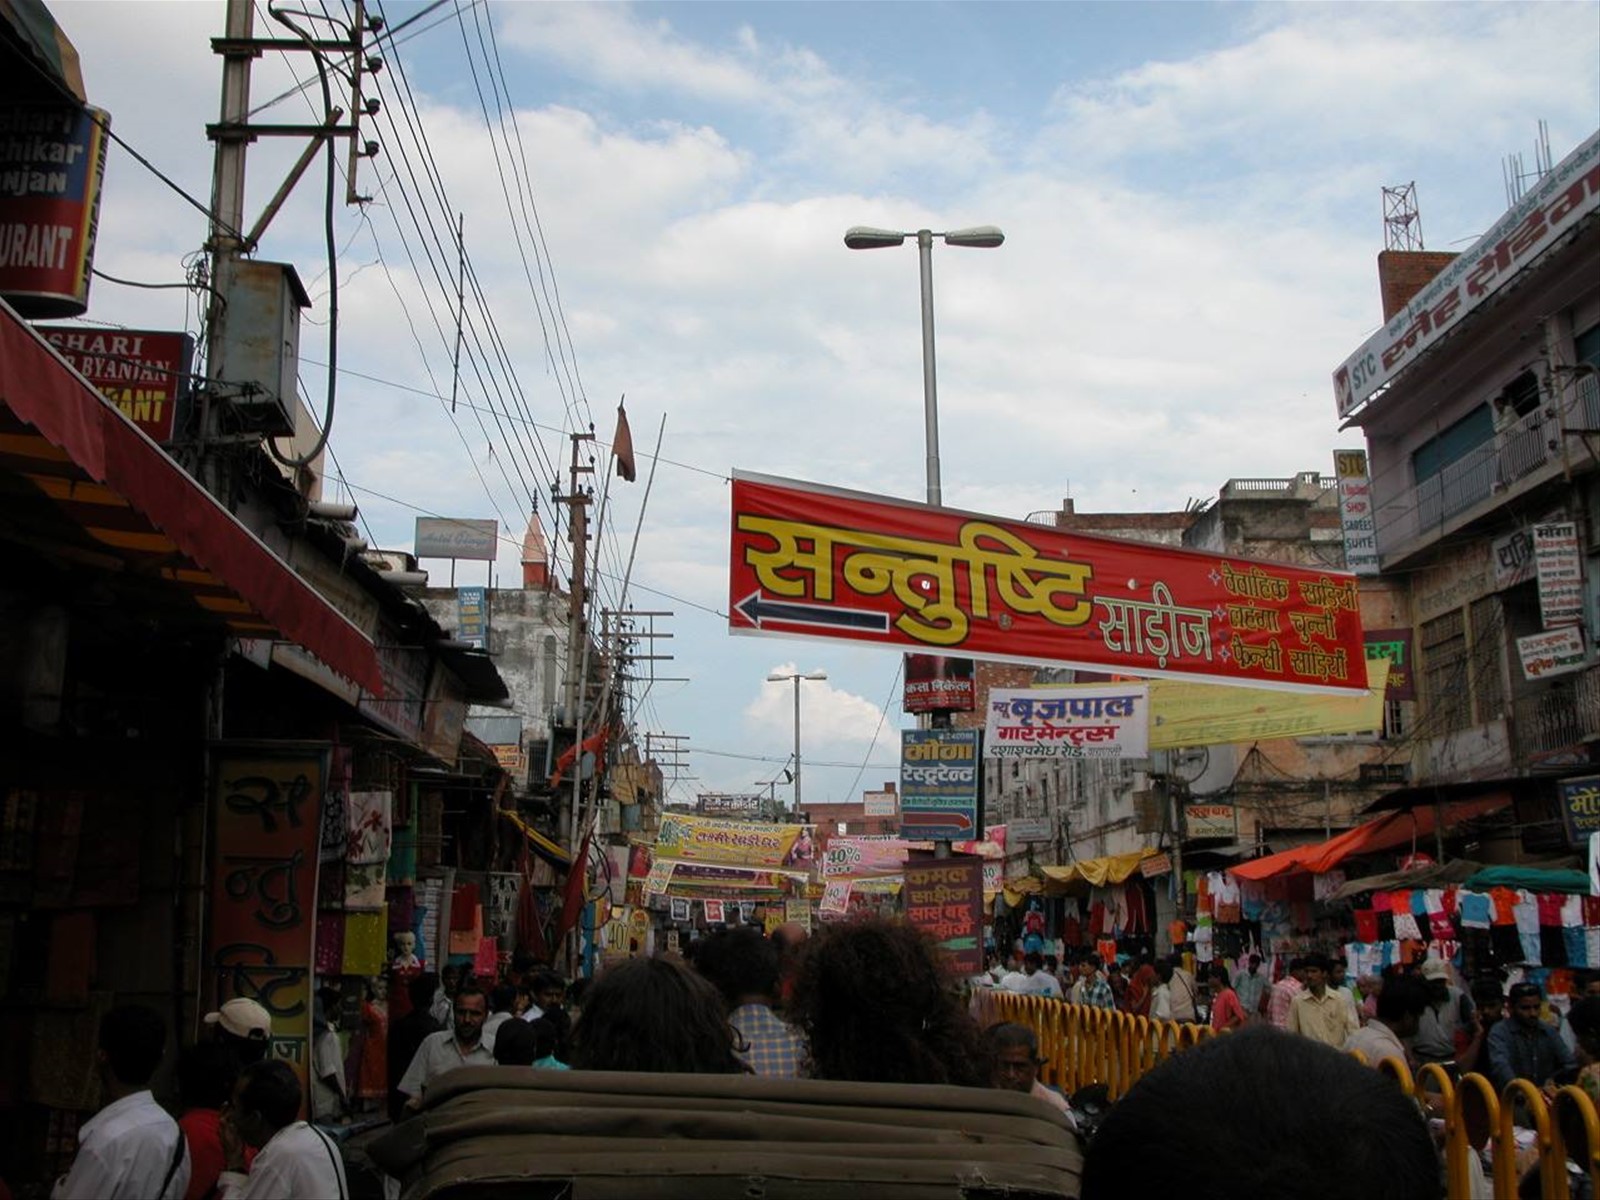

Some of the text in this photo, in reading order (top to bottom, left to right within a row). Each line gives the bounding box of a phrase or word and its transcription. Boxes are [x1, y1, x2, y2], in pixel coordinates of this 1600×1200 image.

[1352, 353, 1376, 390] STC
[737, 514, 1093, 645] सन्तुष्टि
[827, 846, 861, 864] 40%
[827, 866, 853, 874] OFF
